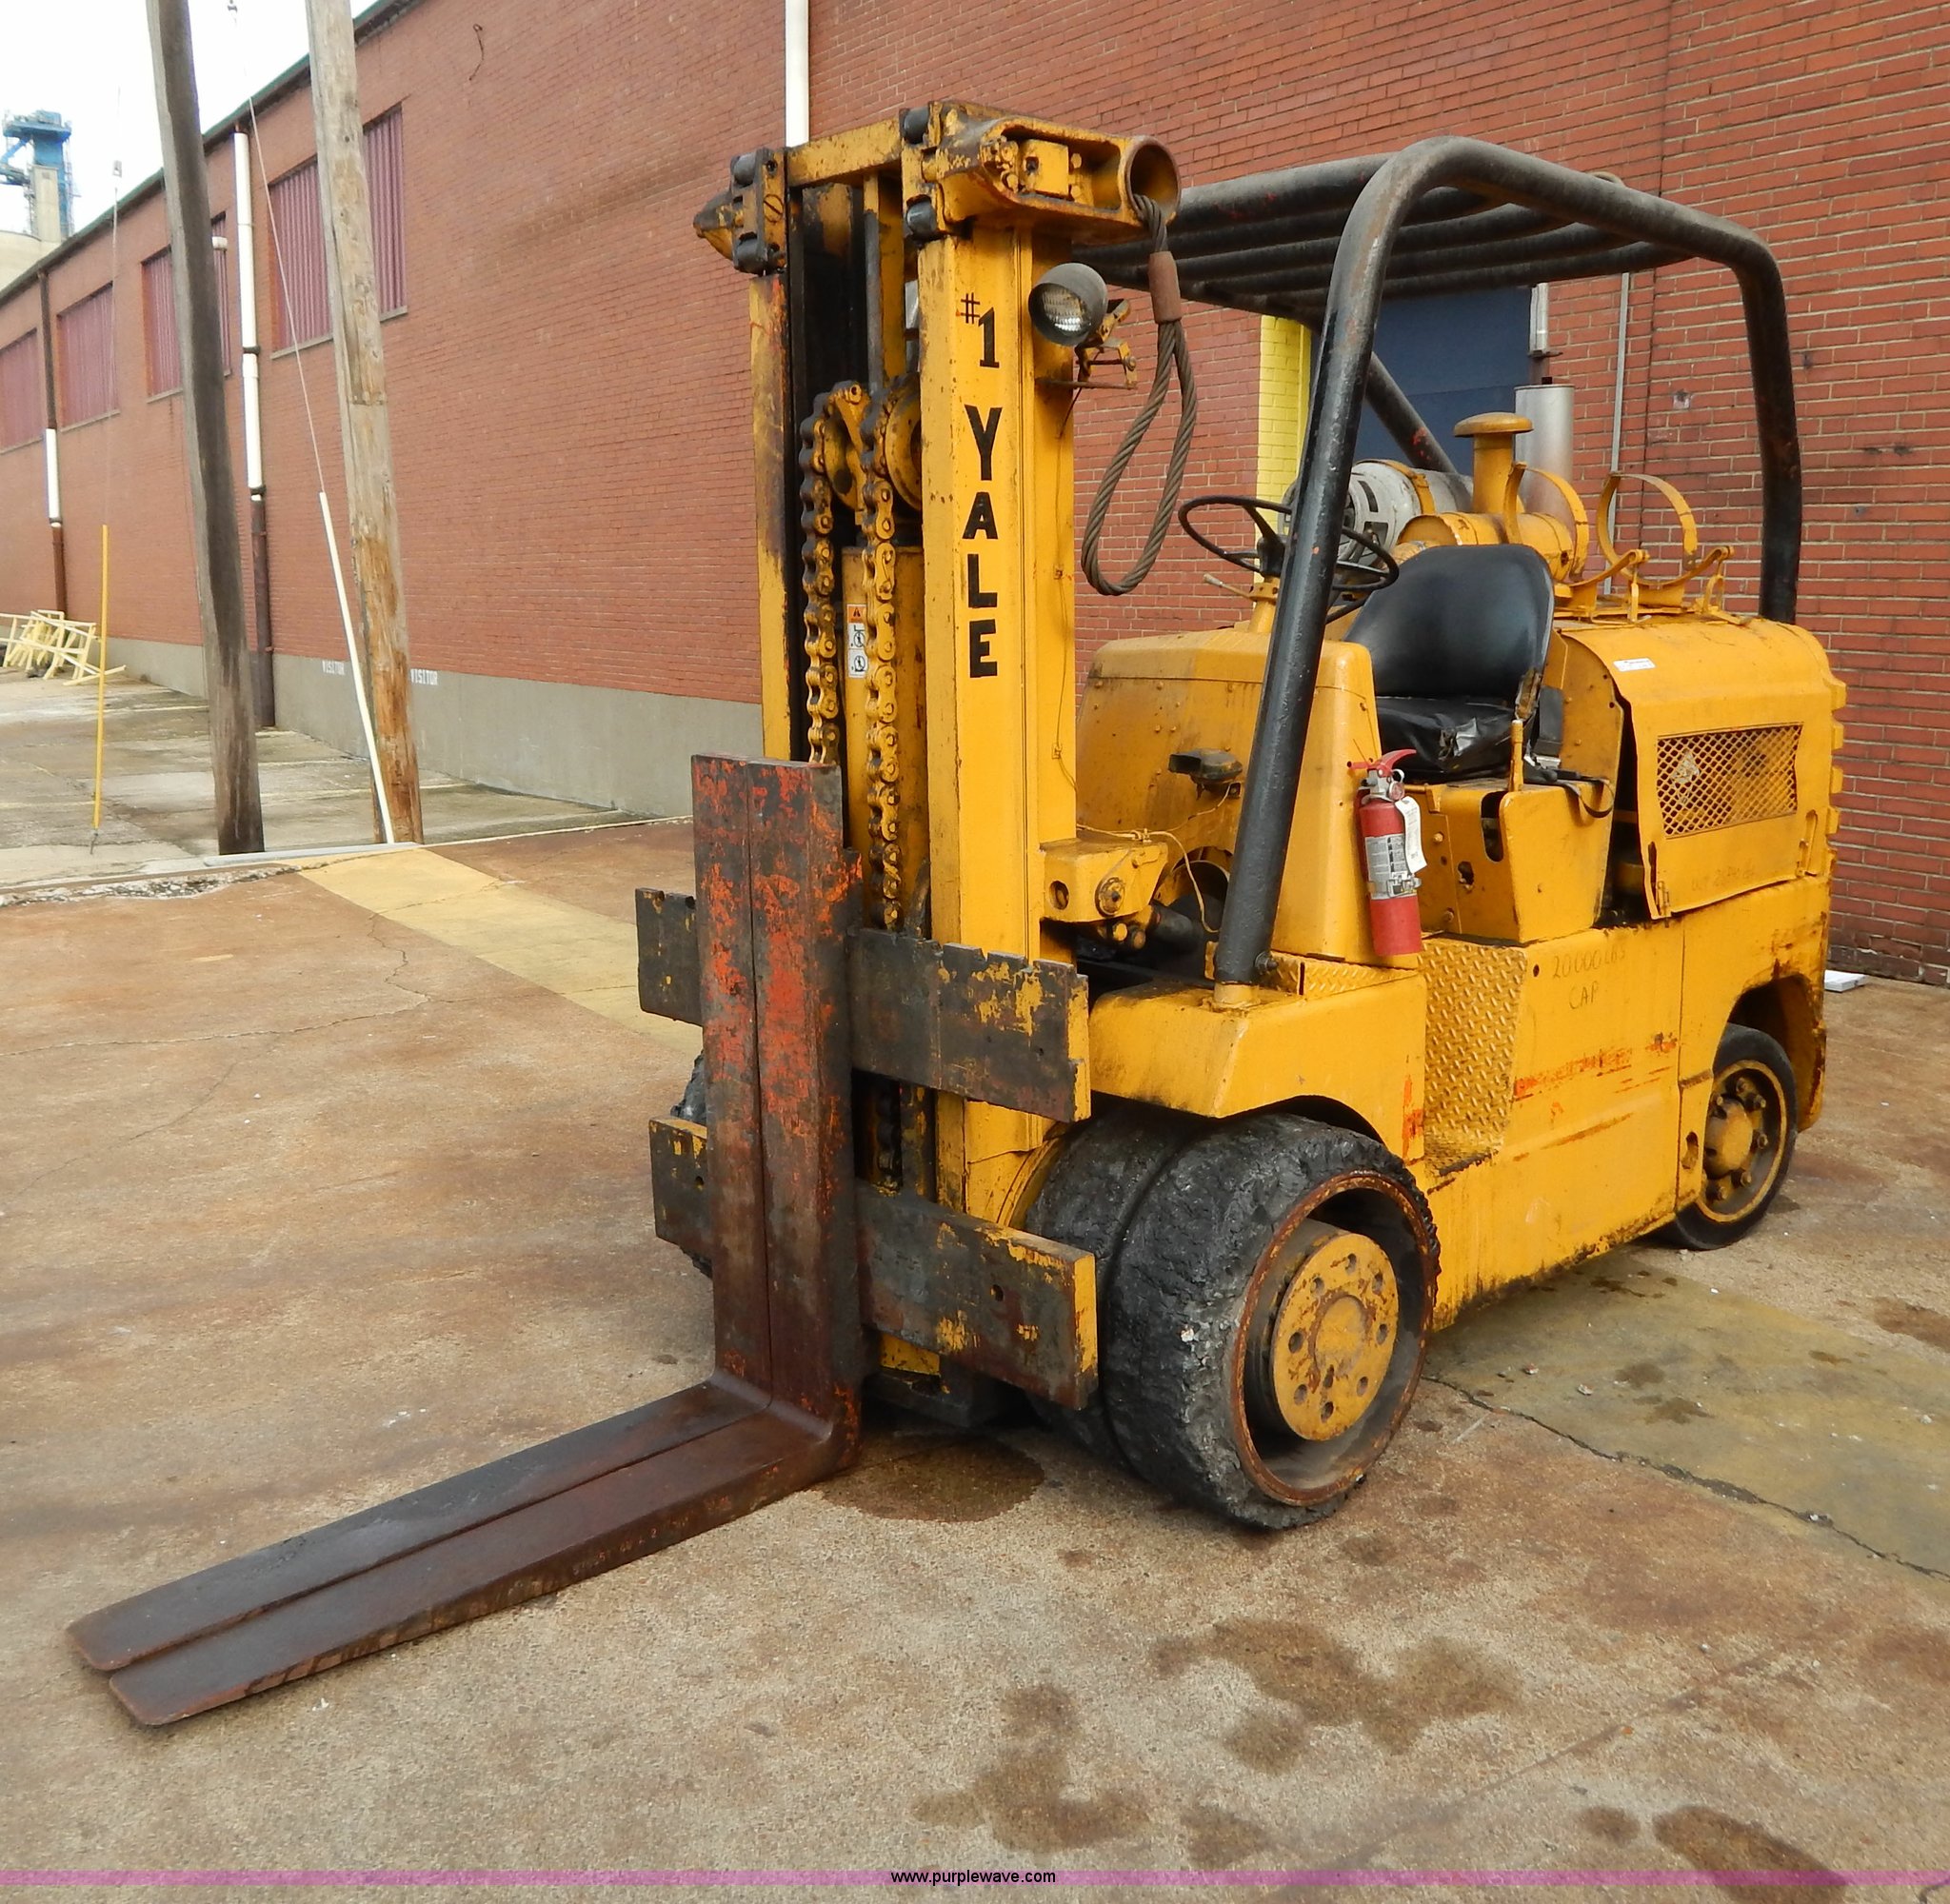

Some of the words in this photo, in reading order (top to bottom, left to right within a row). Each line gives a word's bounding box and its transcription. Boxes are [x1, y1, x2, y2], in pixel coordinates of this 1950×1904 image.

[962, 404, 1003, 678] YALE
[322, 660, 345, 676] VISITOR
[410, 668, 438, 685] VISITOR
[1569, 980, 1600, 1010] CAP
